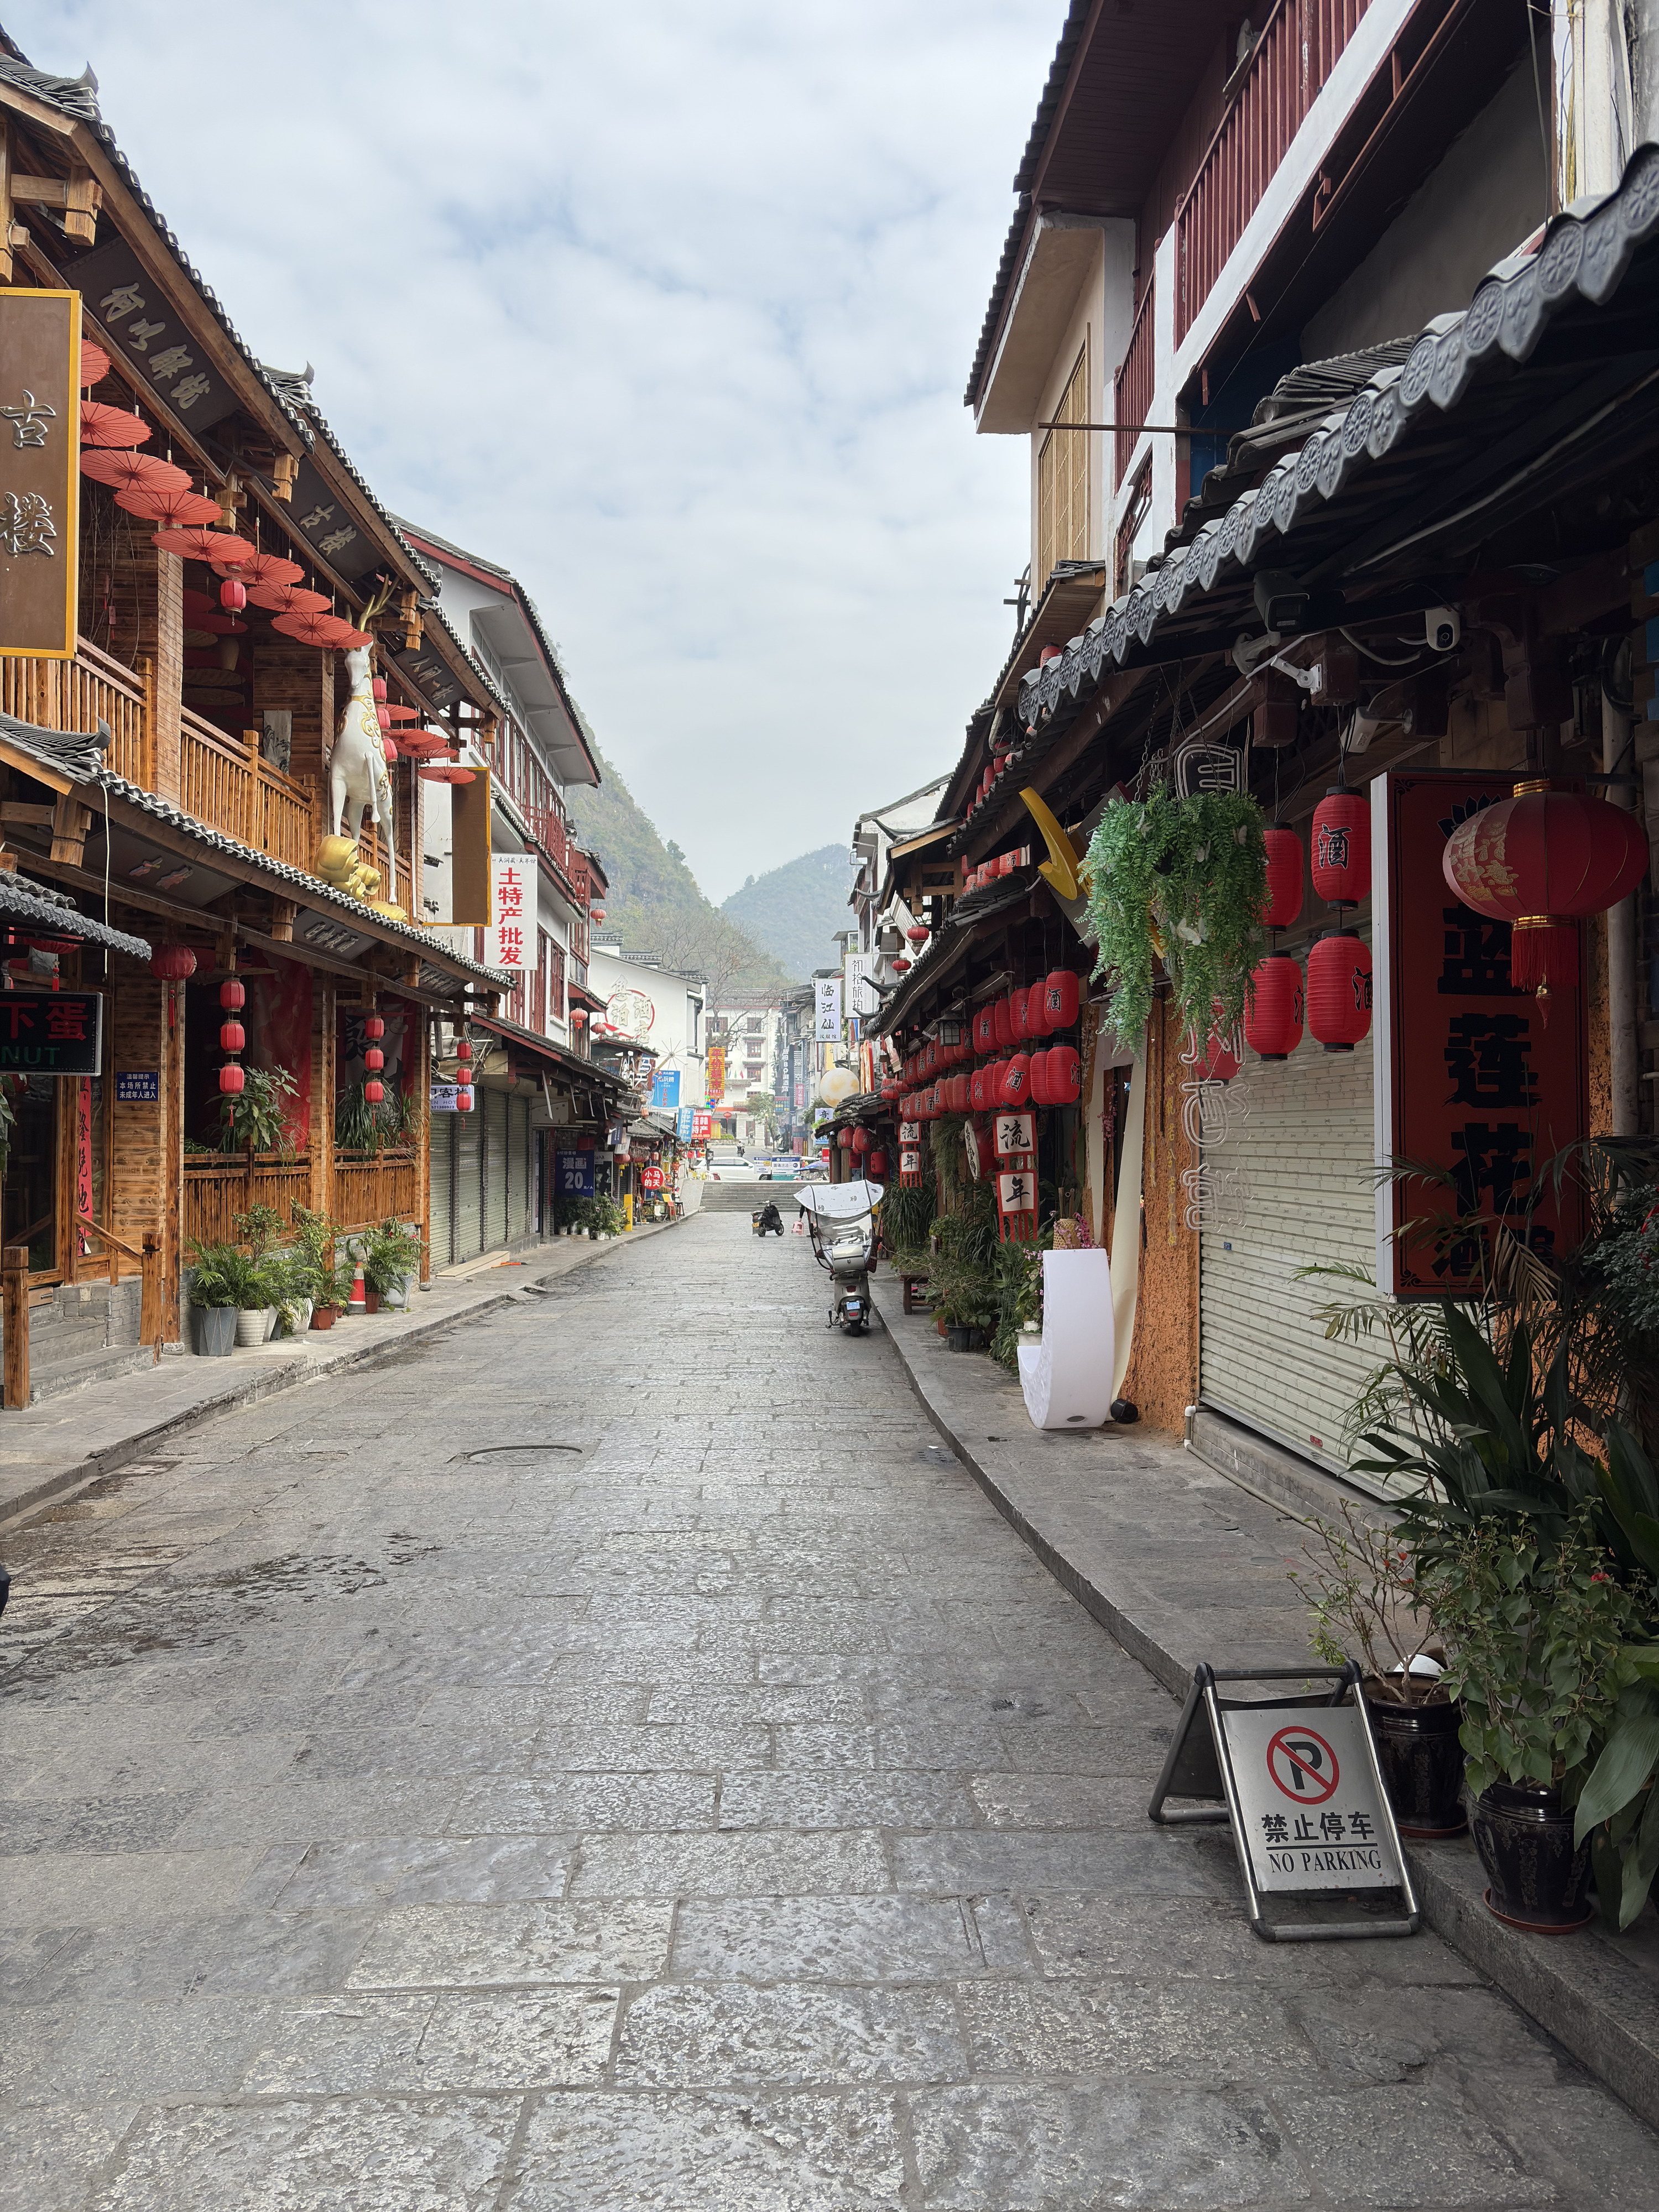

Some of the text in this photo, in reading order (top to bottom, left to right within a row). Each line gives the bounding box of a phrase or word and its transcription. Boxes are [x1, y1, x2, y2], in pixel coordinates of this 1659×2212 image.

[1006, 853, 1017, 867] 酒
[1318, 823, 1353, 870] 酒
[498, 867, 523, 966] 土特产批发
[821, 983, 836, 1030] 临江仙
[1046, 987, 1063, 1012] 酒
[0, 1001, 88, 1041] 下蛋
[633, 995, 651, 1044] 酒店
[1006, 1066, 1027, 1092] 酒
[901, 1124, 918, 1170] 流年
[562, 1157, 587, 1170] 漫画
[645, 1171, 661, 1179] 小马
[999, 1120, 1031, 1206] 流年
[565, 1171, 583, 1190] 20
[644, 1178, 660, 1187] 的天
[1261, 1812, 1375, 1843] 禁止停车
[1268, 1849, 1382, 1873] NO PARKING
